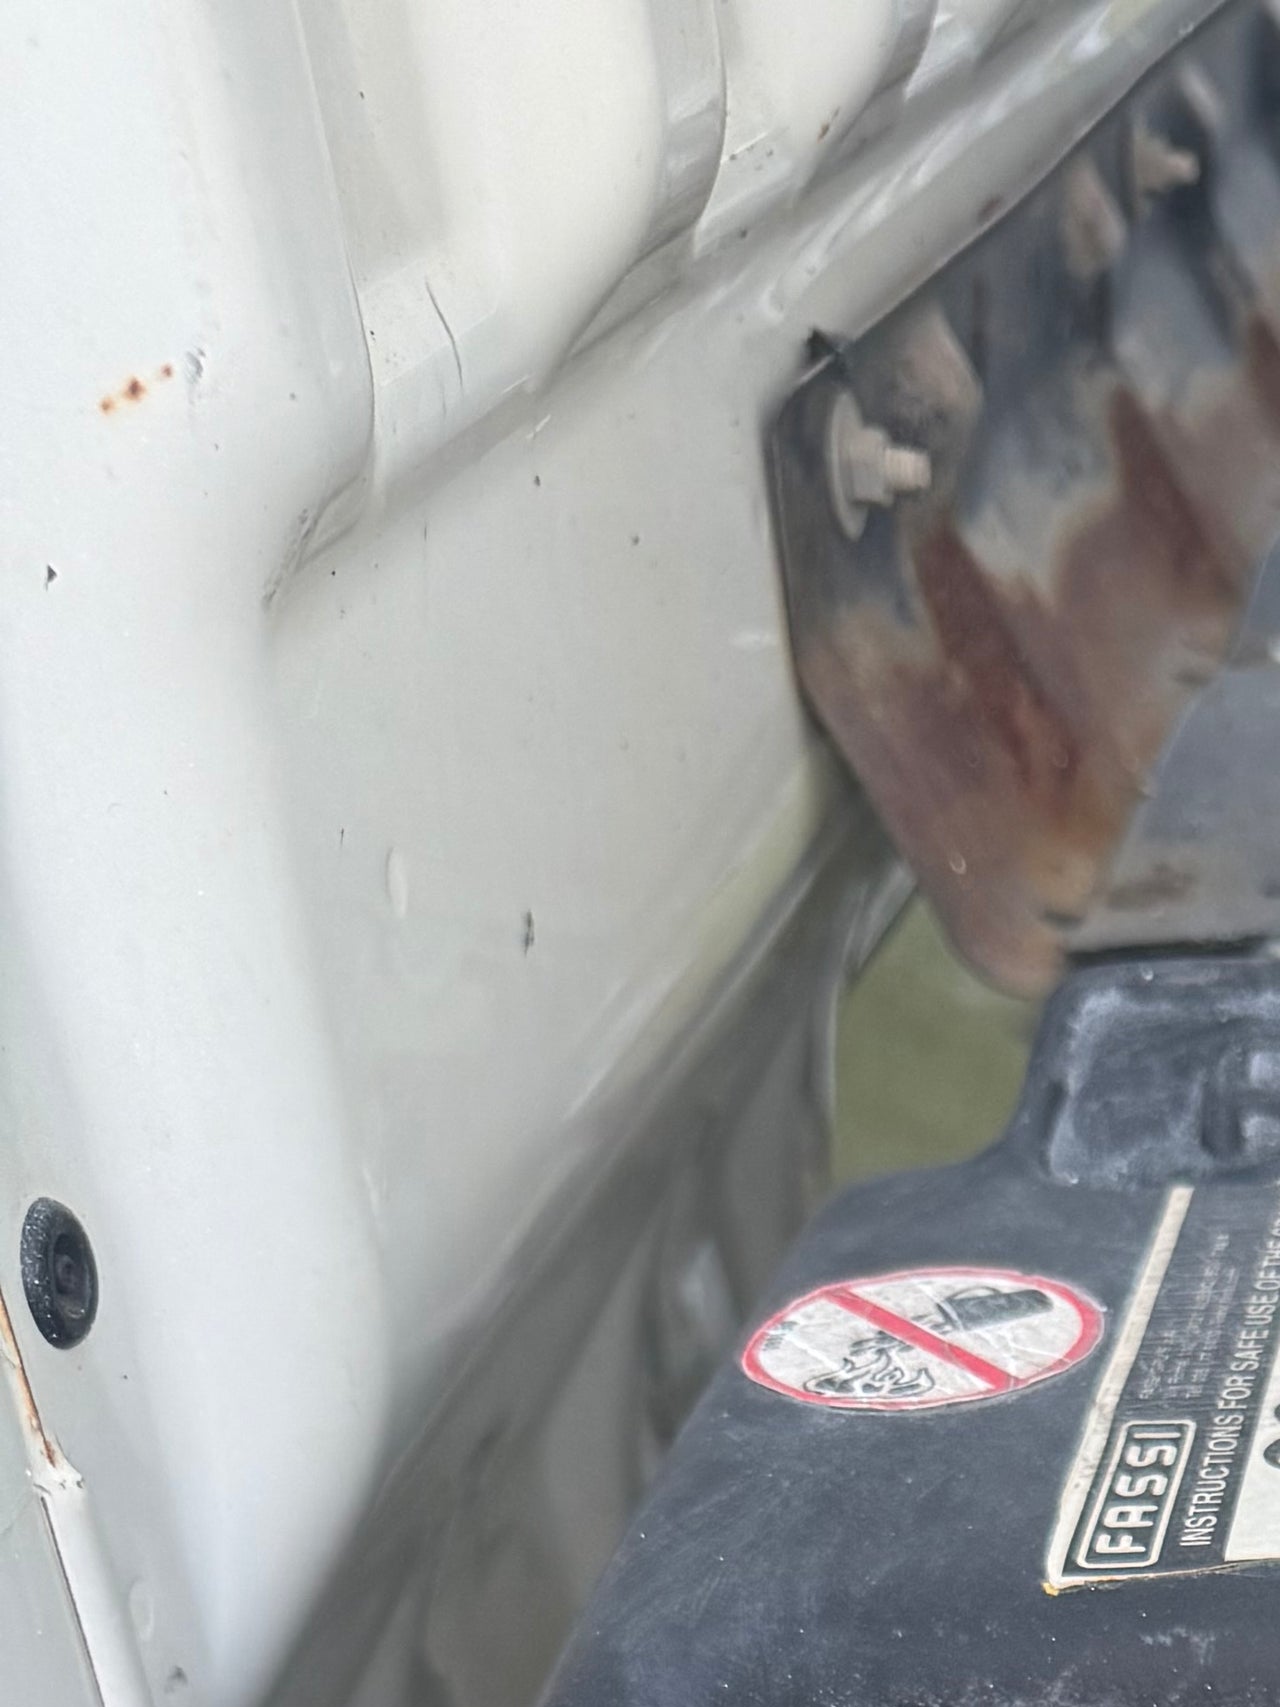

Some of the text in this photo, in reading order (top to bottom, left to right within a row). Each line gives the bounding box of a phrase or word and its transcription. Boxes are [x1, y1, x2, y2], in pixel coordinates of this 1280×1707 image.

[1244, 1294, 1278, 1324] USE
[1229, 1329, 1268, 1370] SAFE
[1218, 1375, 1254, 1408] FOR
[1095, 1431, 1182, 1554] FASSI
[1179, 1414, 1243, 1545] INSTRUCTIONS
